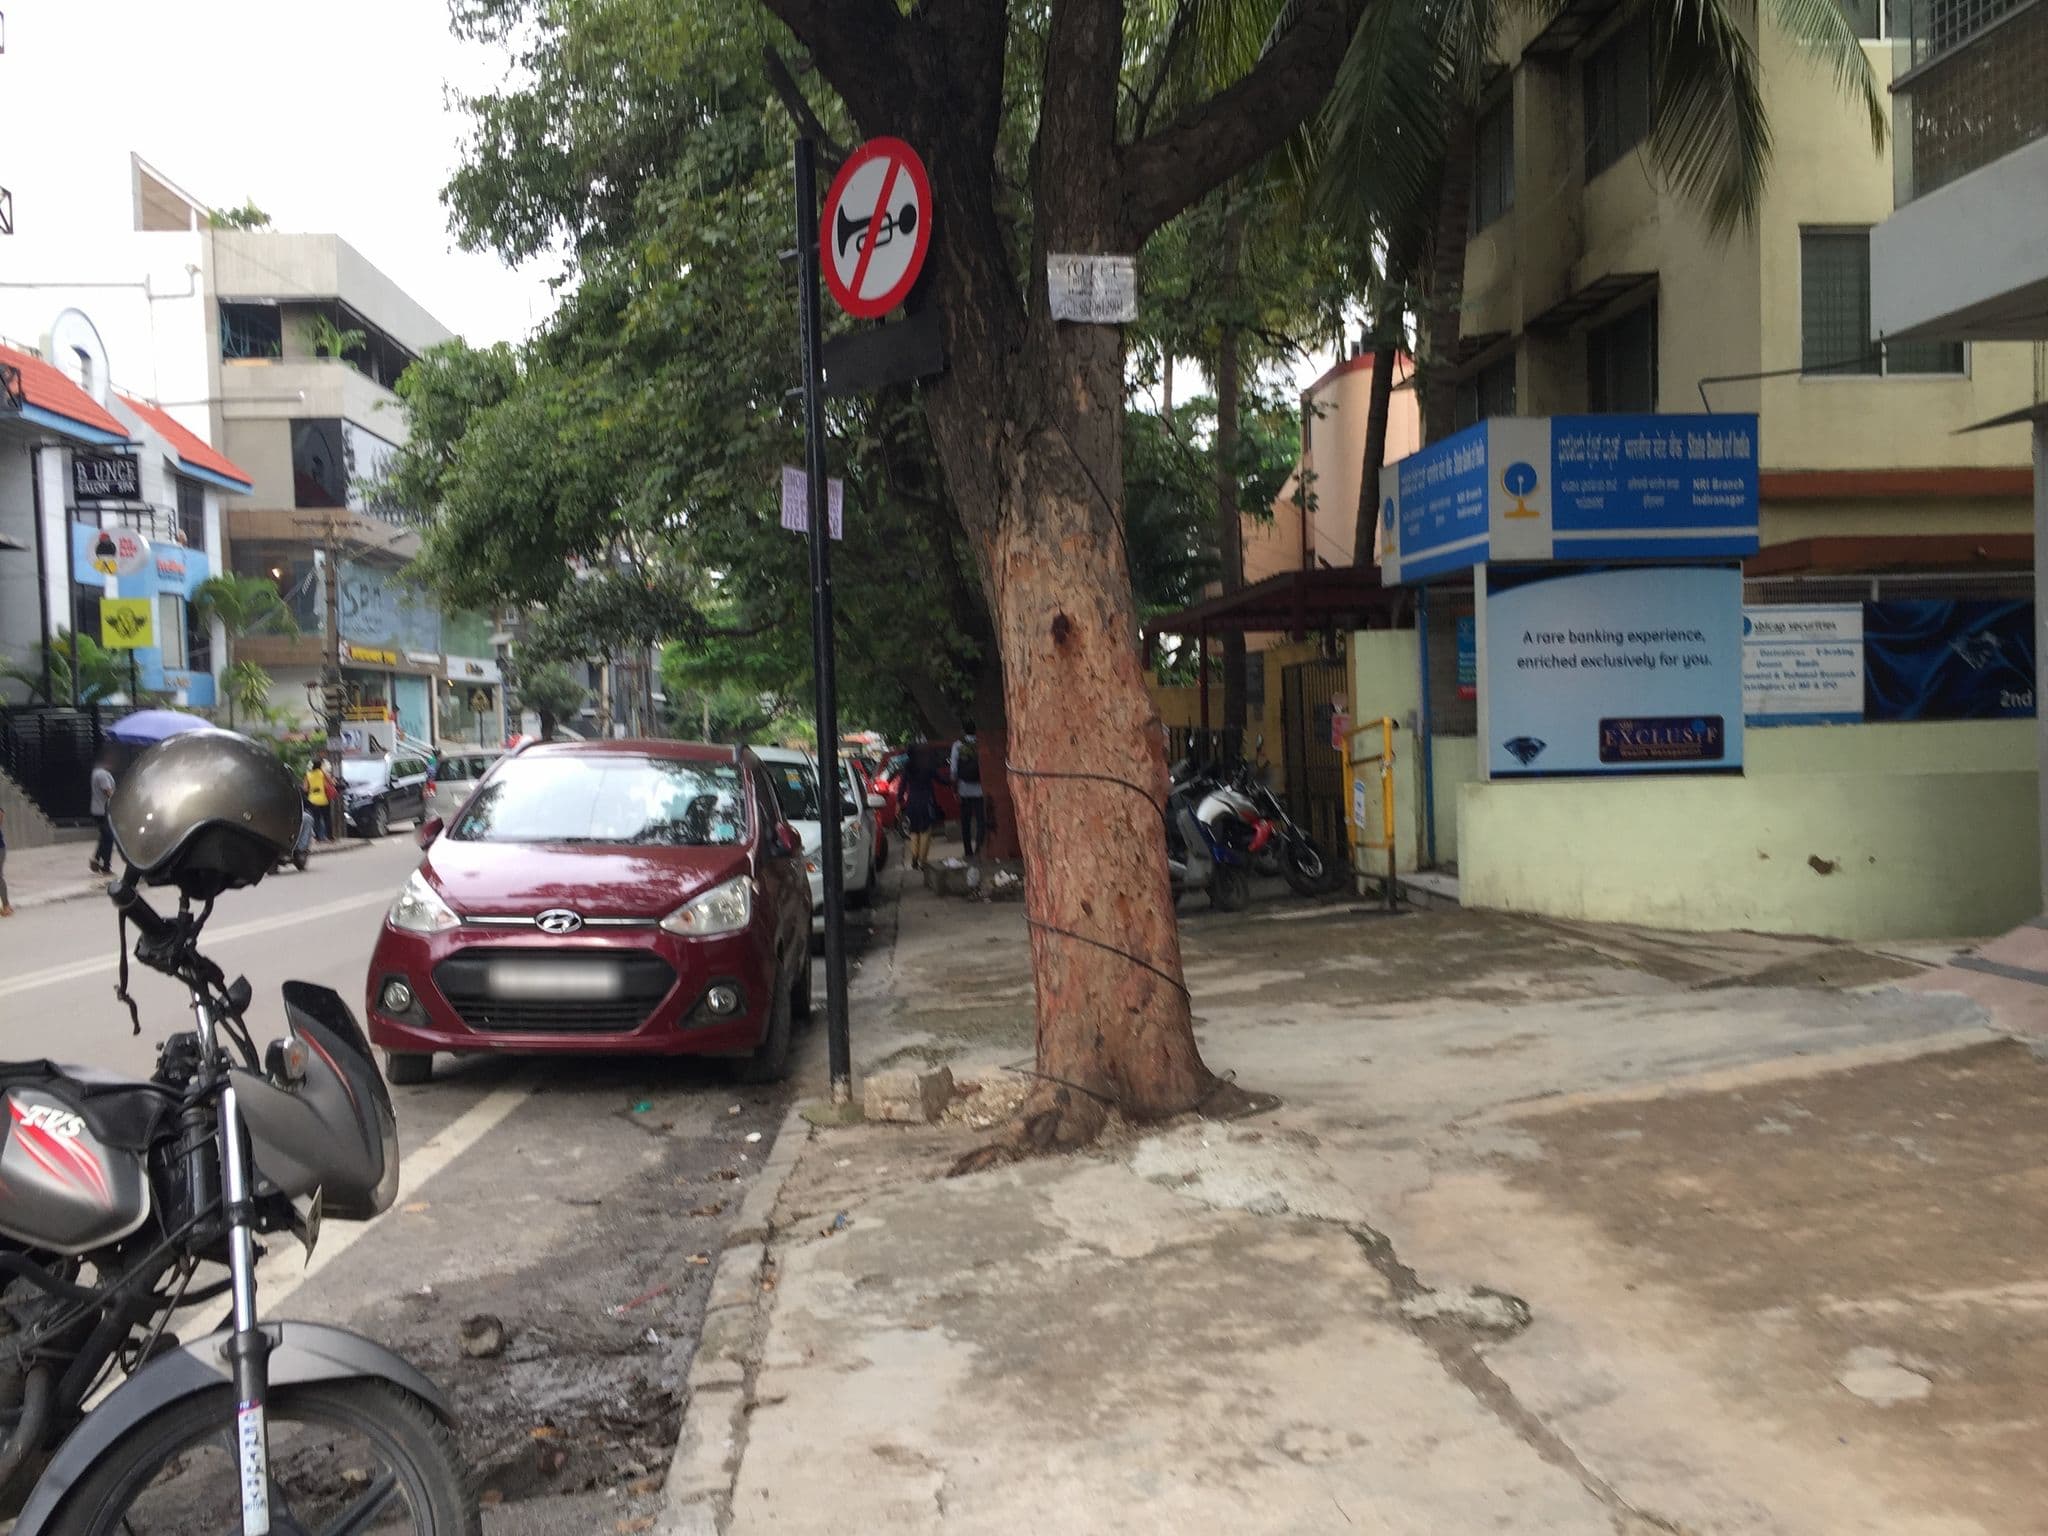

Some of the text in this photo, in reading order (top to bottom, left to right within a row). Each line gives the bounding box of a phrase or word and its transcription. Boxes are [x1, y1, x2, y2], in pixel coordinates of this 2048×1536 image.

[1688, 431, 1705, 459] State
[1707, 431, 1723, 459] Bank
[1733, 431, 1749, 459] India
[75, 460, 137, 482] BUNCE
[1693, 478, 1710, 491] NRI
[1712, 478, 1745, 491] Branch
[1692, 493, 1745, 508] Indiranagar
[1522, 628, 1706, 646] A rare banking experience,
[1517, 652, 1712, 670] enriched exclusively for you.
[2000, 688, 2033, 708] 2nd
[20, 1104, 86, 1137] TVS
